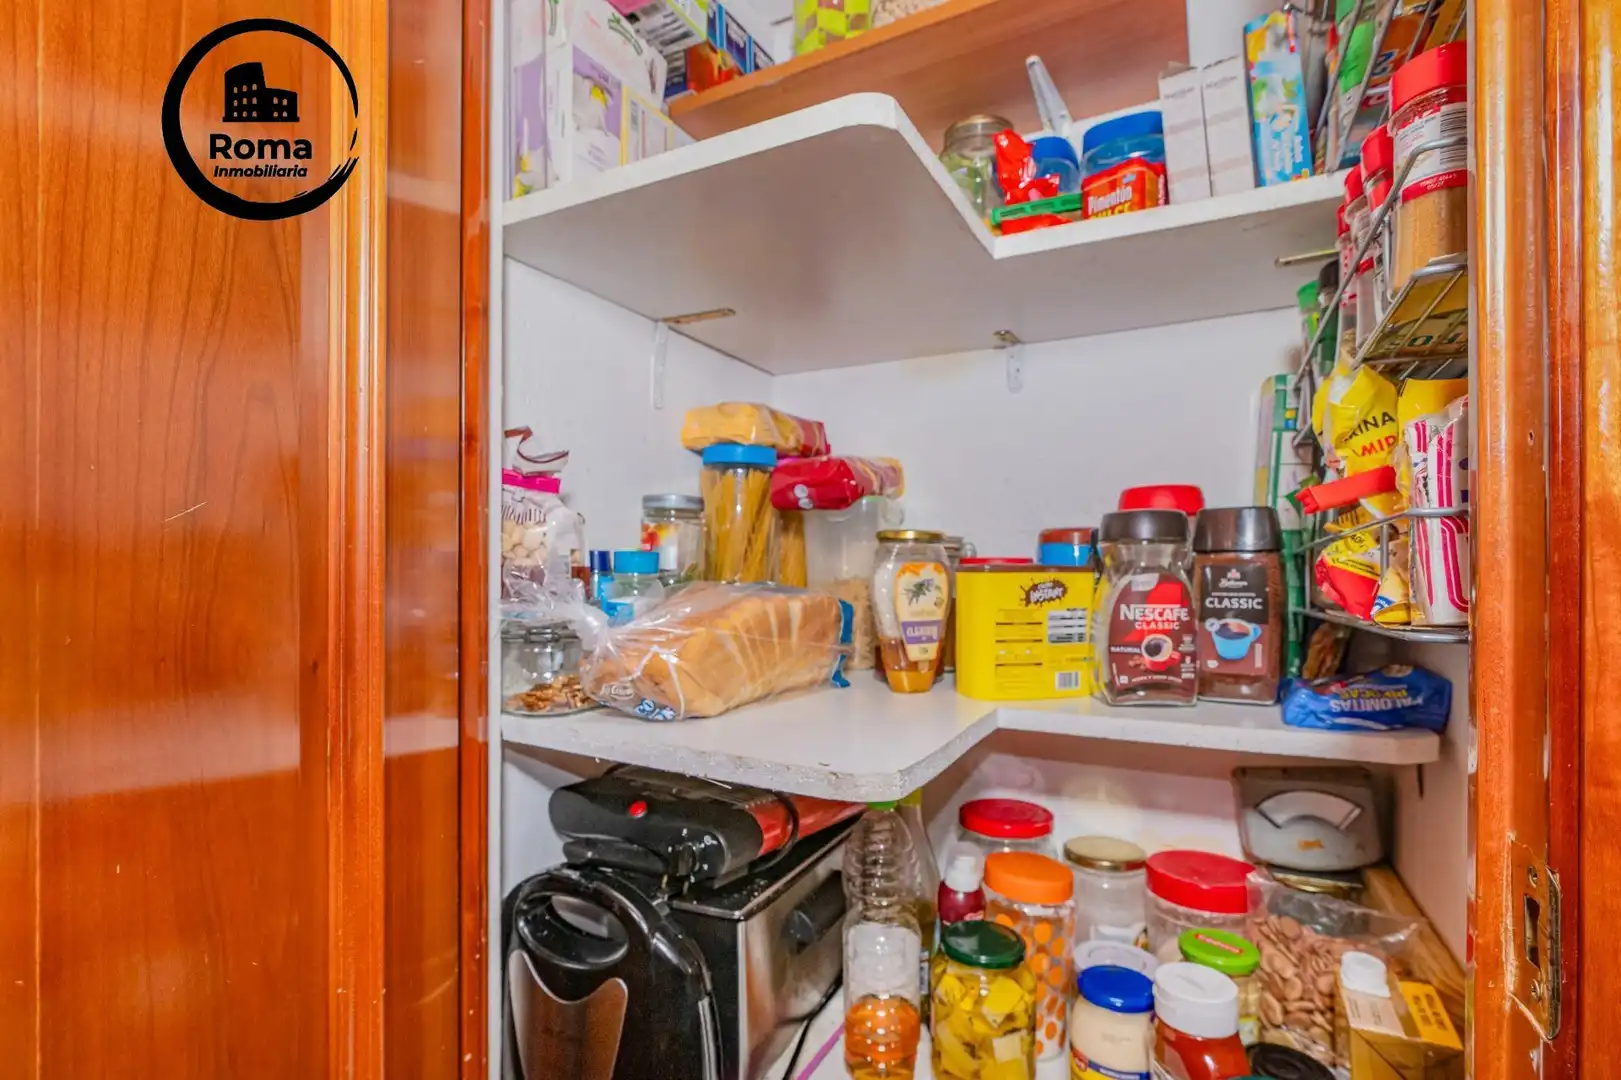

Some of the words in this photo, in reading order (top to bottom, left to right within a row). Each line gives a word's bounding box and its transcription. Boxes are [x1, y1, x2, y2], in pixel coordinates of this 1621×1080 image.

[1204, 596, 1264, 610] CLASSIC
[1134, 621, 1181, 631] CLASSIC
[1110, 645, 1142, 654] NATURAL
